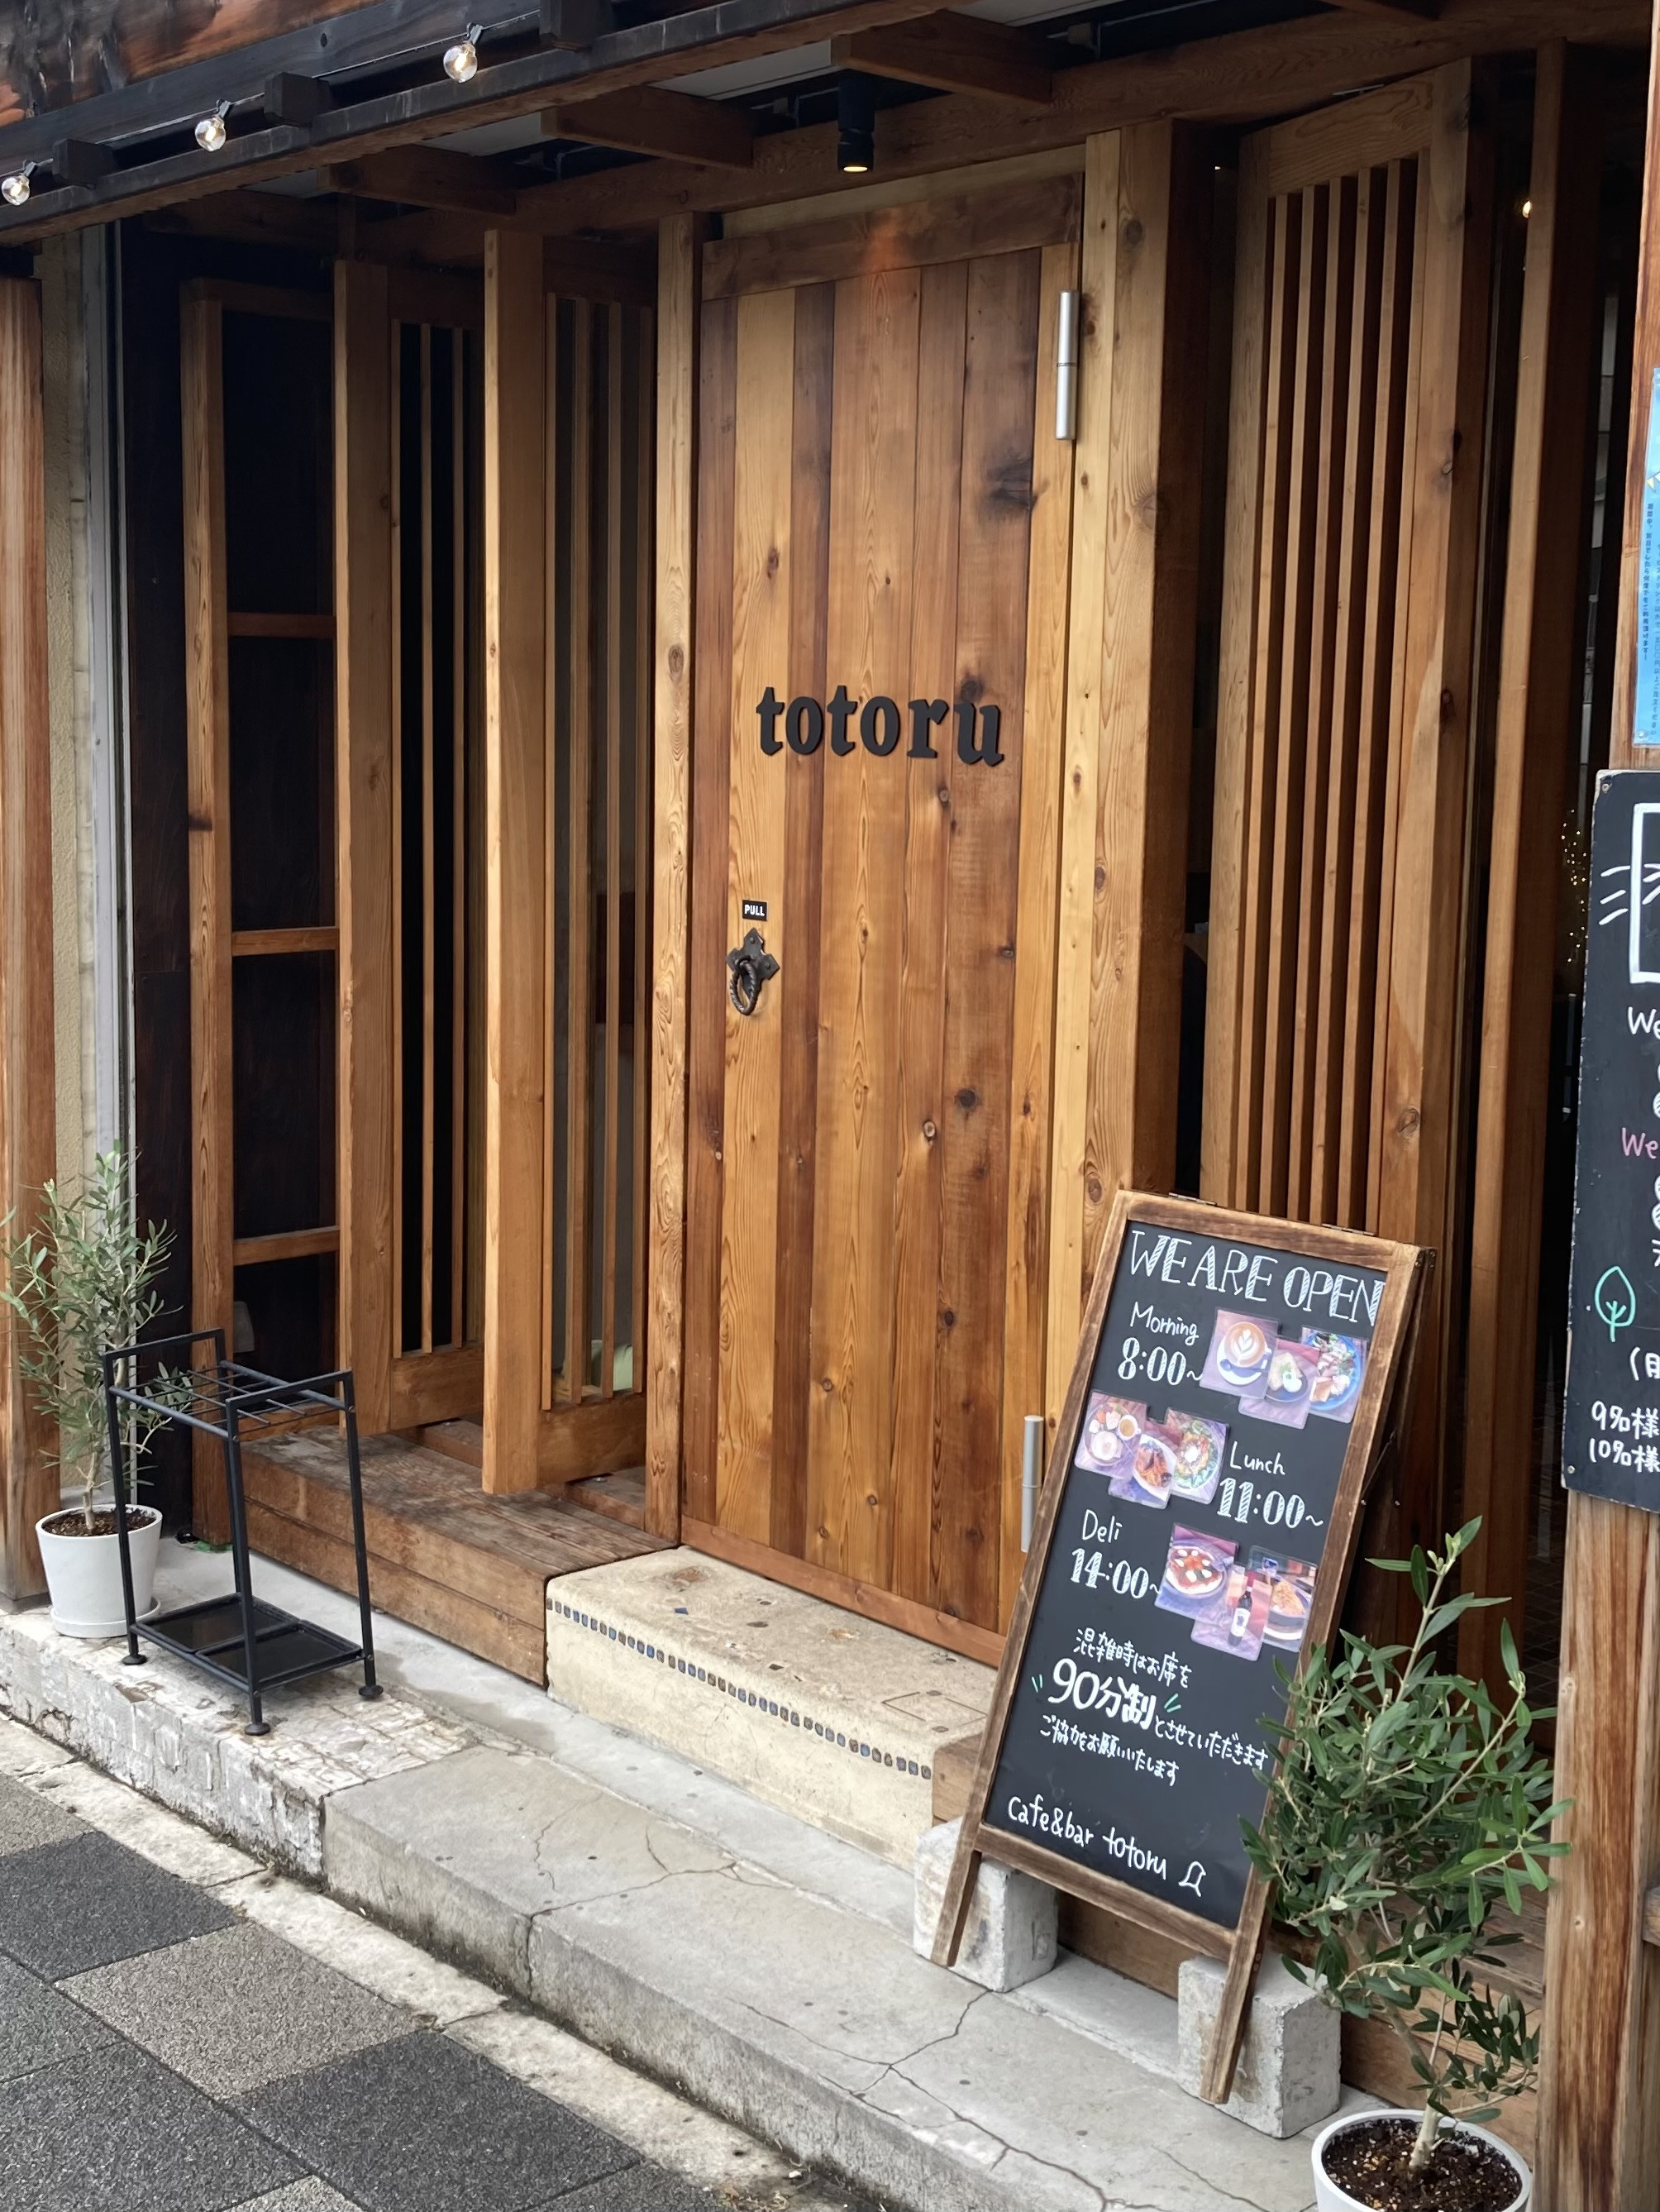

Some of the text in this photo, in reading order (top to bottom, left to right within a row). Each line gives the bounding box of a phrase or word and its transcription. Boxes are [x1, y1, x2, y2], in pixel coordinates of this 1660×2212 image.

[756, 685, 1004, 767] totoru
[744, 904, 766, 917] PULL
[1132, 1230, 1386, 1327] WE ARE OPEN
[1129, 1301, 1200, 1346] Morning
[1229, 1441, 1286, 1476] Lunch
[1081, 1509, 1123, 1543] Deli
[1073, 1627, 1193, 1689] 混雑時はお席を
[1039, 1714, 1180, 1786] ご協力をお願いいたします
[1102, 1827, 1166, 1881] totoru
